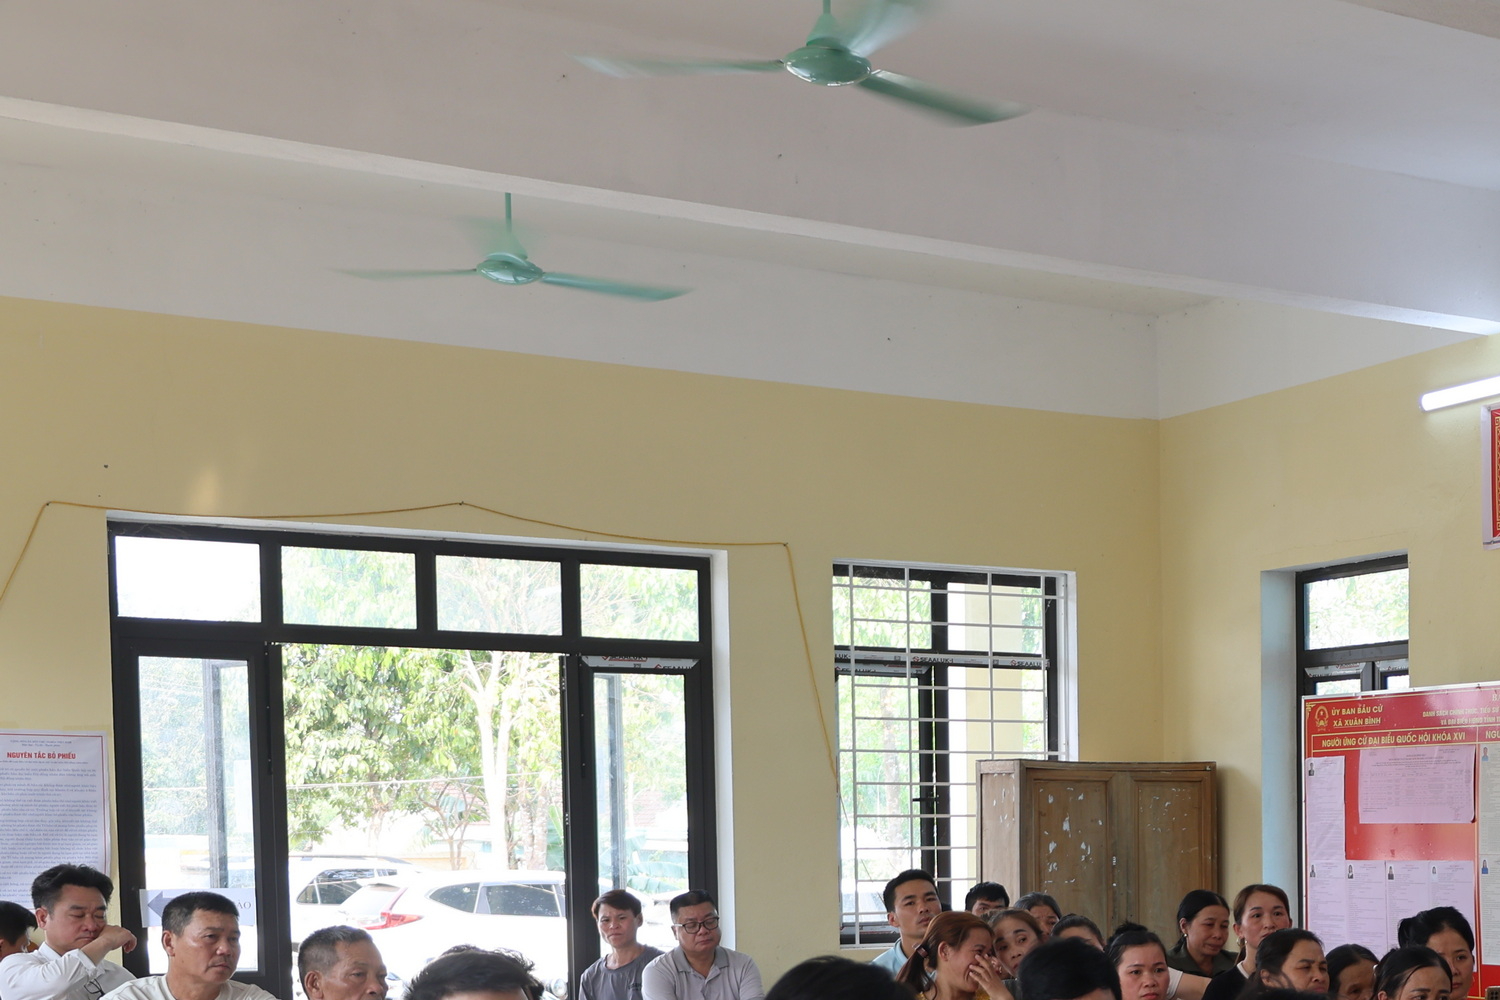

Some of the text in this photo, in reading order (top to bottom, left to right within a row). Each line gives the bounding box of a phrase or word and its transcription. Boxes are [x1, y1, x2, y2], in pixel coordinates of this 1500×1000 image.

[1331, 704, 1384, 716] ỦY BAN BẦU CỬ
[1333, 716, 1381, 727] XÃ XUÂN BÌNH
[1322, 731, 1466, 748] NGƯỜI ỨNG CỬ ĐẠI BIỂU QUỐC HỘI KHÓA XVI
